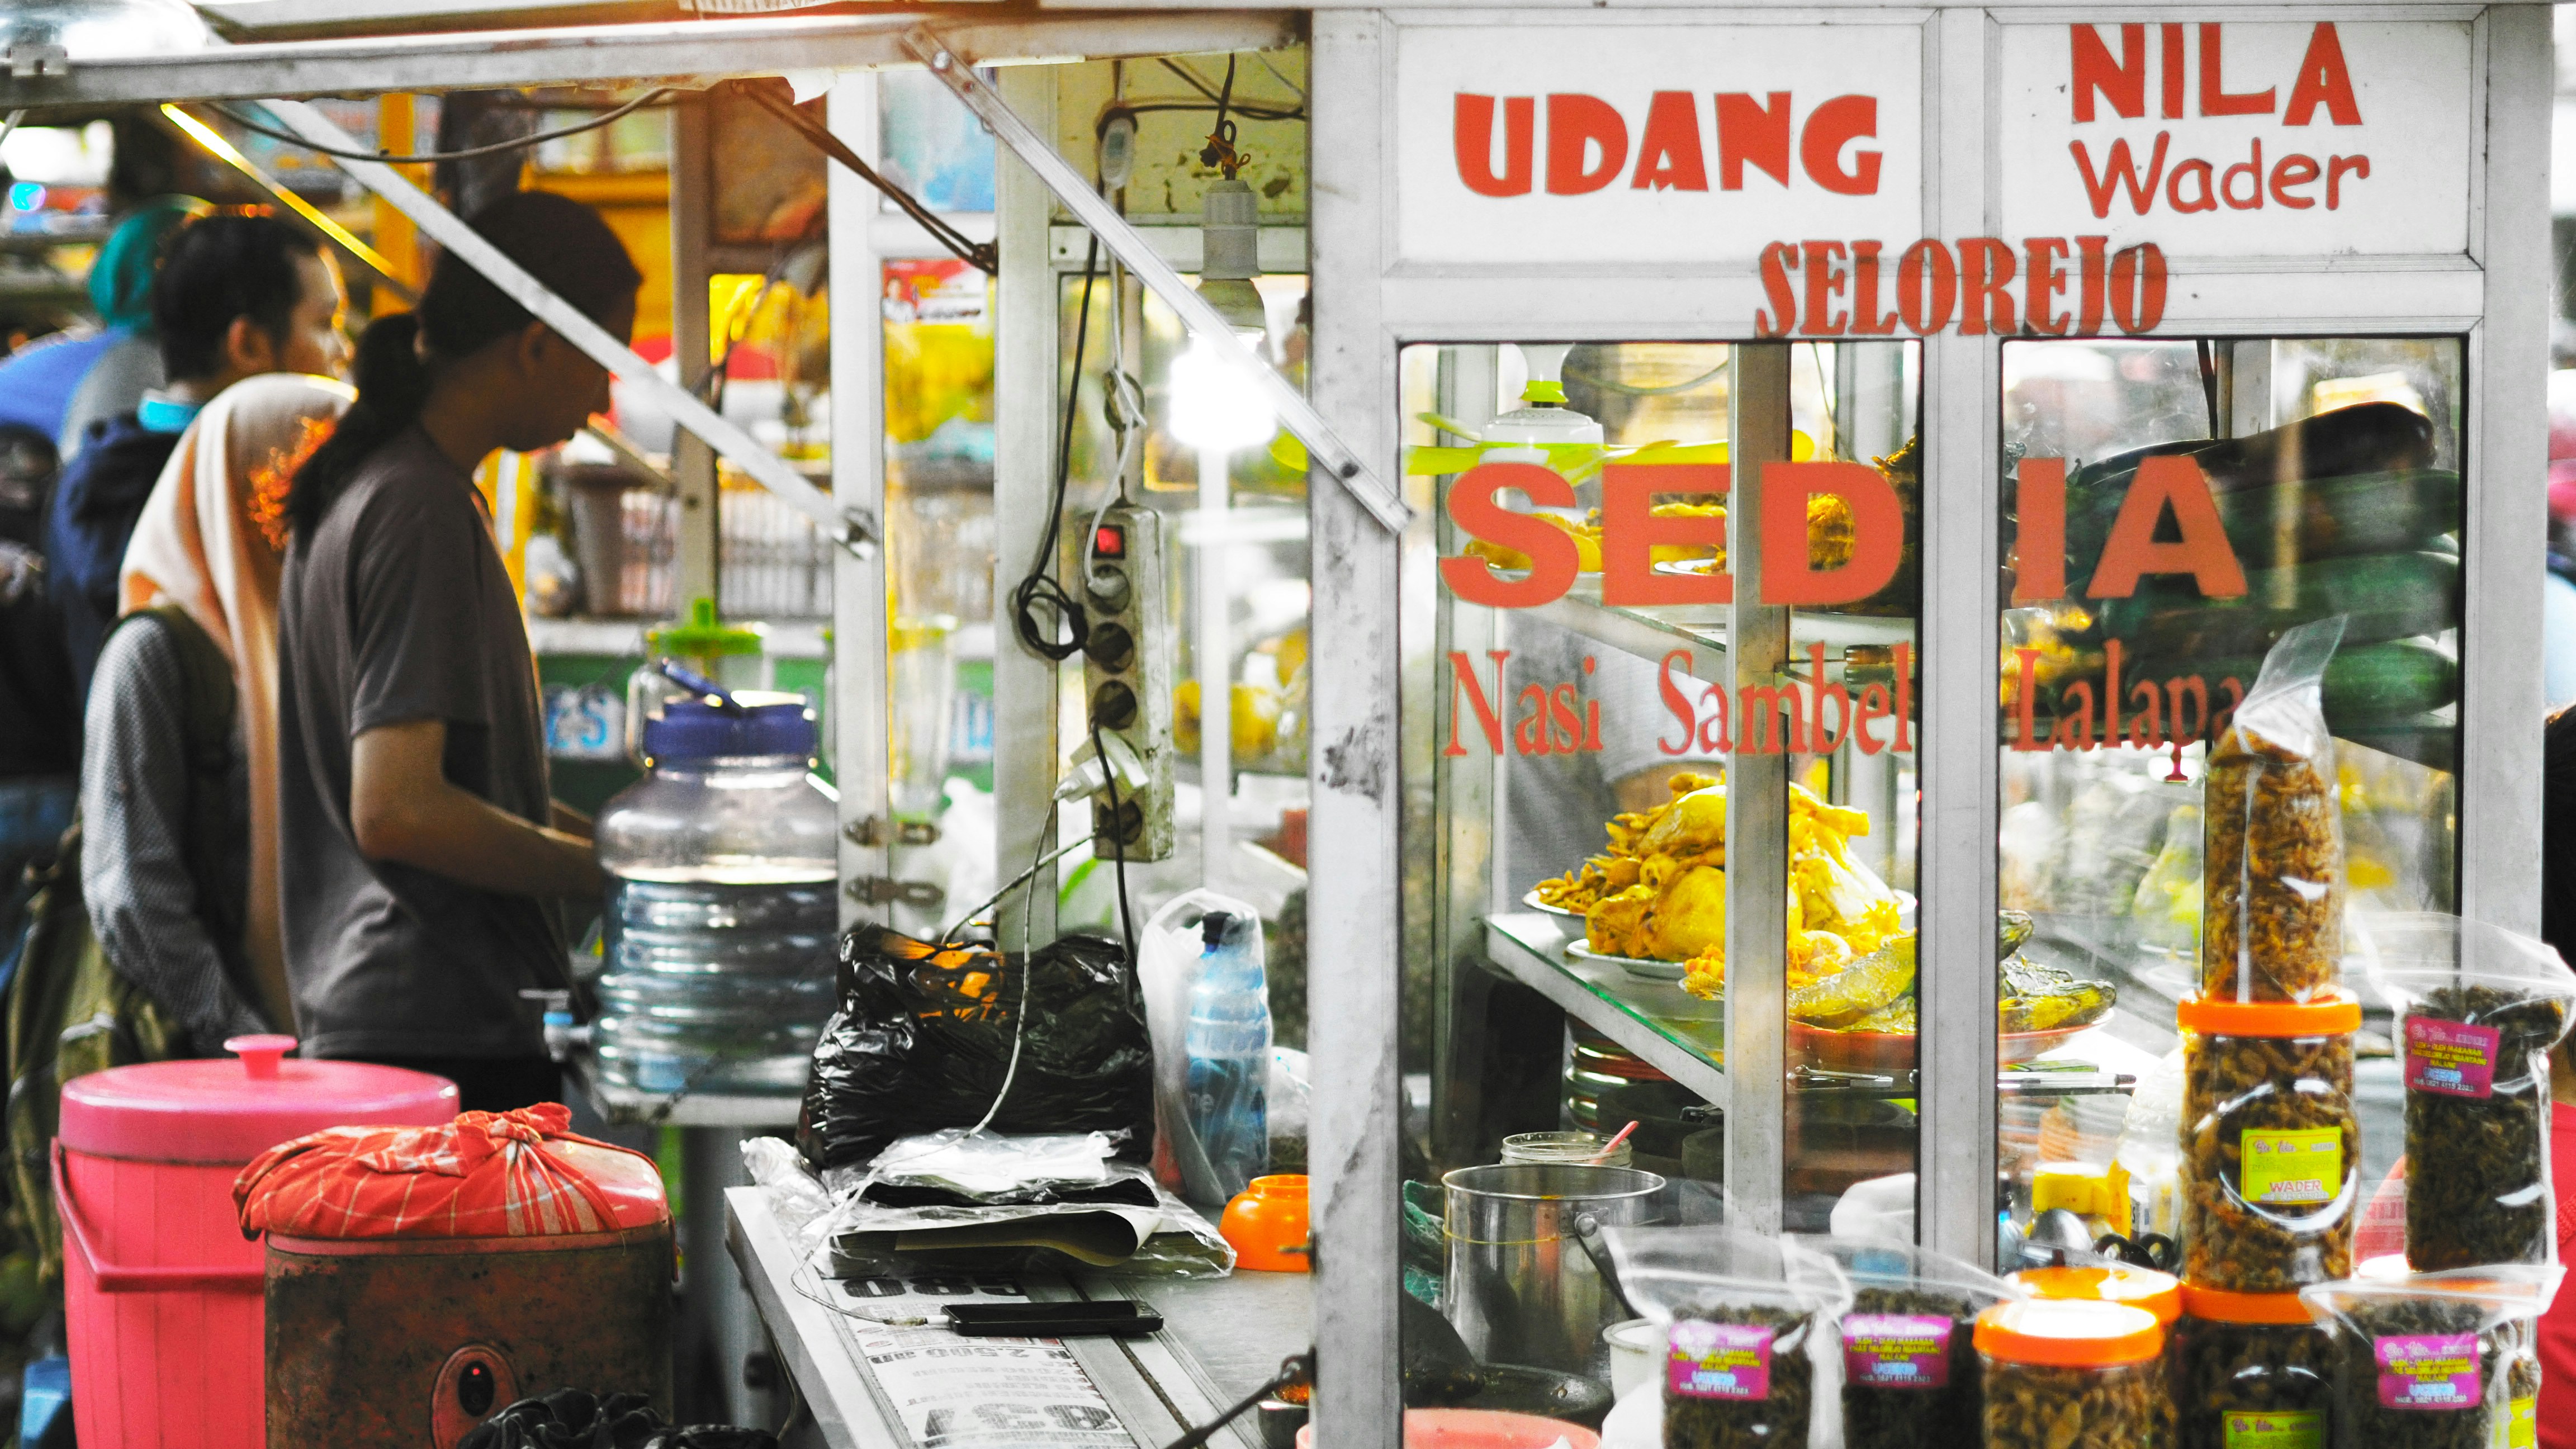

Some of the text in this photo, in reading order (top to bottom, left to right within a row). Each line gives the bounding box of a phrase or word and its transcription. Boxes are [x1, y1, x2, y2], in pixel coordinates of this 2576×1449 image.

[2070, 21, 2362, 126] NILA
[1454, 91, 1883, 198] UDANG
[2070, 130, 2370, 219] Wader
[1756, 235, 2168, 339] SELOREJO
[1444, 637, 2245, 783] Nasi Sambel Lalapa
[2270, 1178, 2323, 1192] WADER
[926, 1347, 1030, 1358] 2.500
[924, 1403, 1117, 1438] 837
